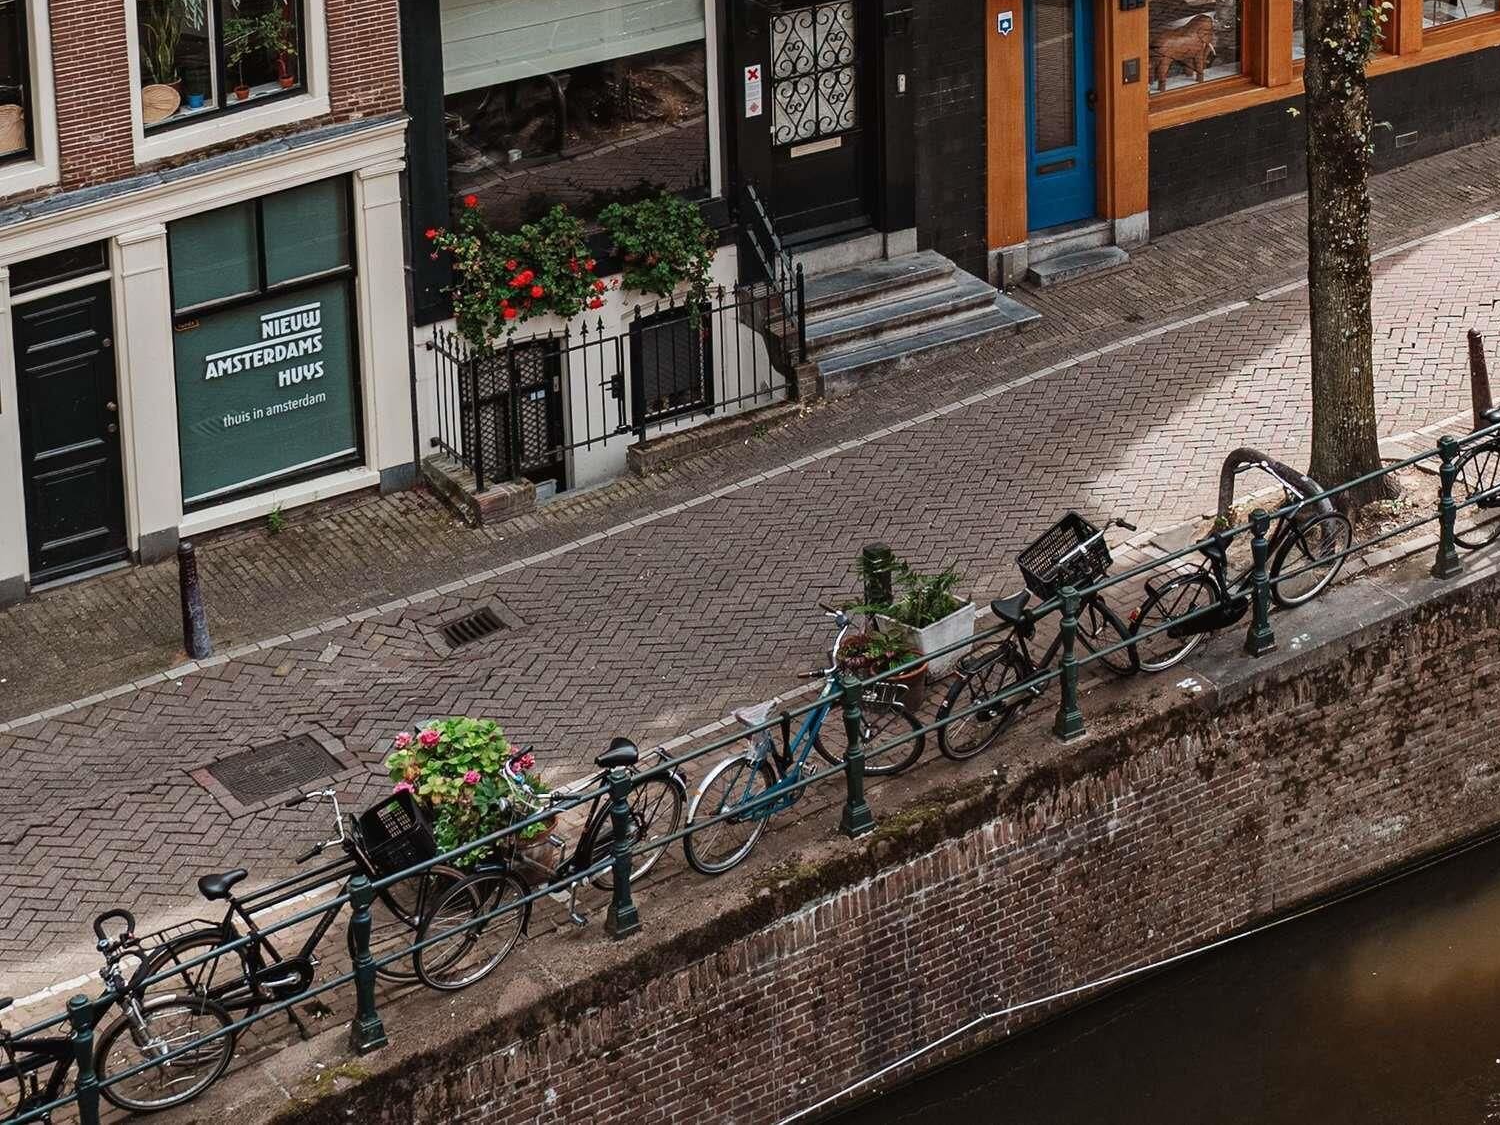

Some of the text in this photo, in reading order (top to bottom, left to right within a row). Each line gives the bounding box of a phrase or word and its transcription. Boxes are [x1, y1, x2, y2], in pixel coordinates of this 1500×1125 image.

[261, 309, 321, 339] NIEUW
[205, 335, 323, 380] AMSTERDAMS
[278, 361, 324, 387] HUYS
[223, 392, 327, 428] thuis in amsterdam
